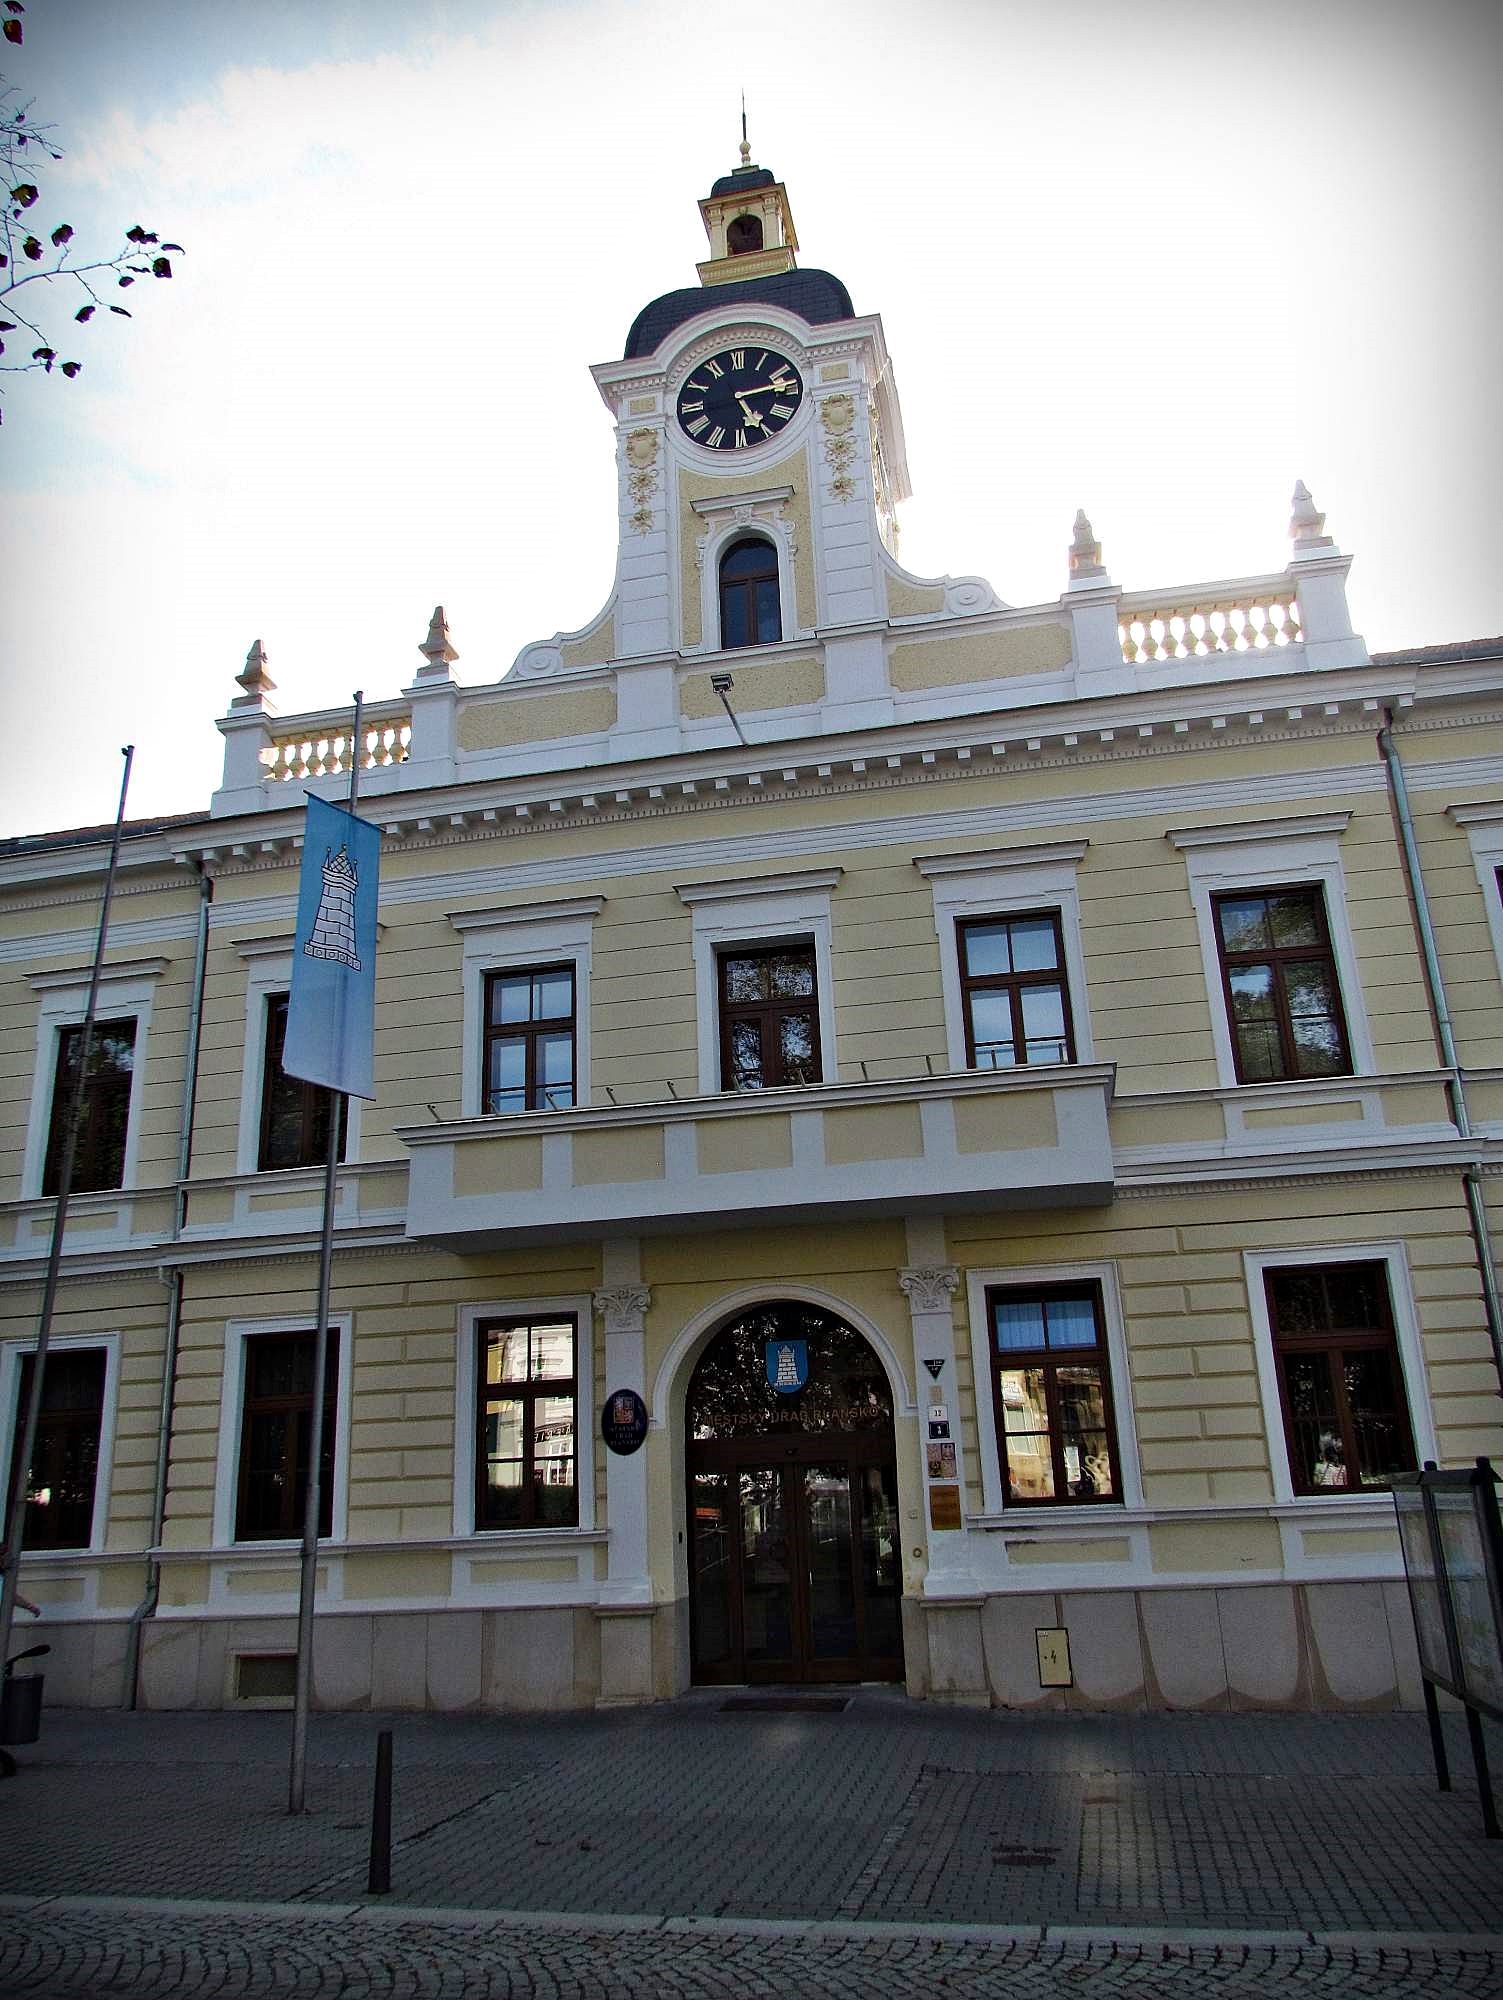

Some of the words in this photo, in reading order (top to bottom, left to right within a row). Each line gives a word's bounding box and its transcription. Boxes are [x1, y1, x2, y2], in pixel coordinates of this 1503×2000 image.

[704, 359, 725, 380] XI
[730, 350, 745, 371] XII
[755, 352, 769, 371] I
[769, 363, 791, 381] II
[686, 379, 709, 393] X
[681, 400, 704, 415] IX
[705, 425, 726, 448] VII
[734, 428, 748, 449] VI
